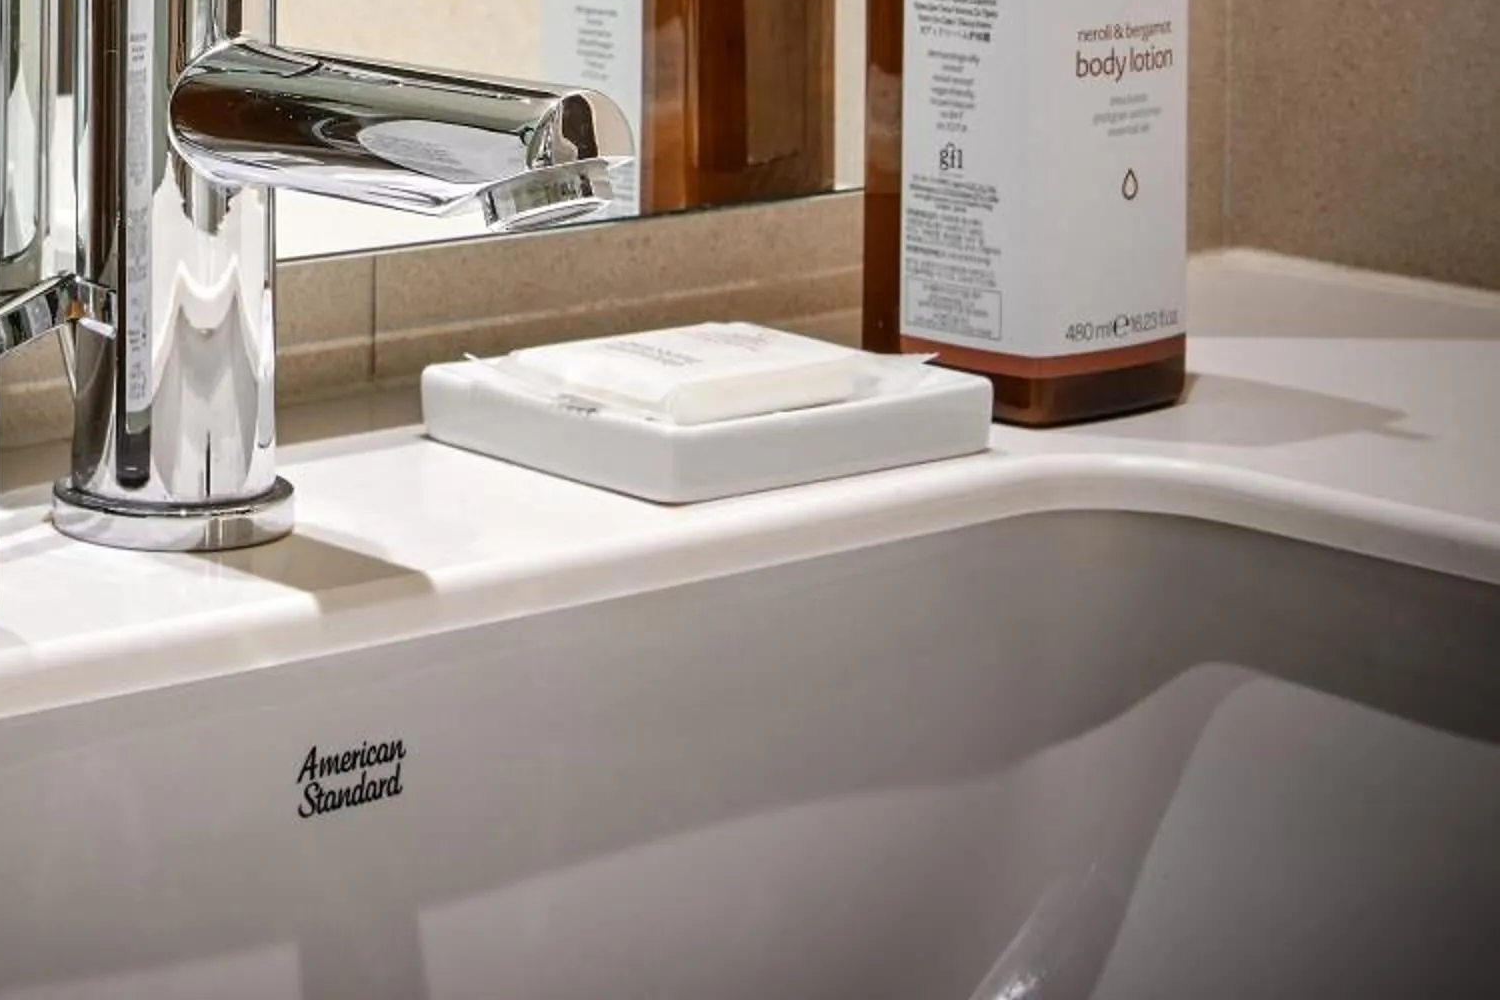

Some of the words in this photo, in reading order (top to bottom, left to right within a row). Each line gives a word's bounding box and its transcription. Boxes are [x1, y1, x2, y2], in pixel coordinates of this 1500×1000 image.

[1077, 23, 1112, 42] neroli
[1113, 22, 1124, 40] &
[1075, 45, 1127, 84] body
[1129, 44, 1174, 73] lotion
[1065, 321, 1094, 342] 480
[296, 739, 407, 785] American
[298, 762, 404, 819] Standard
